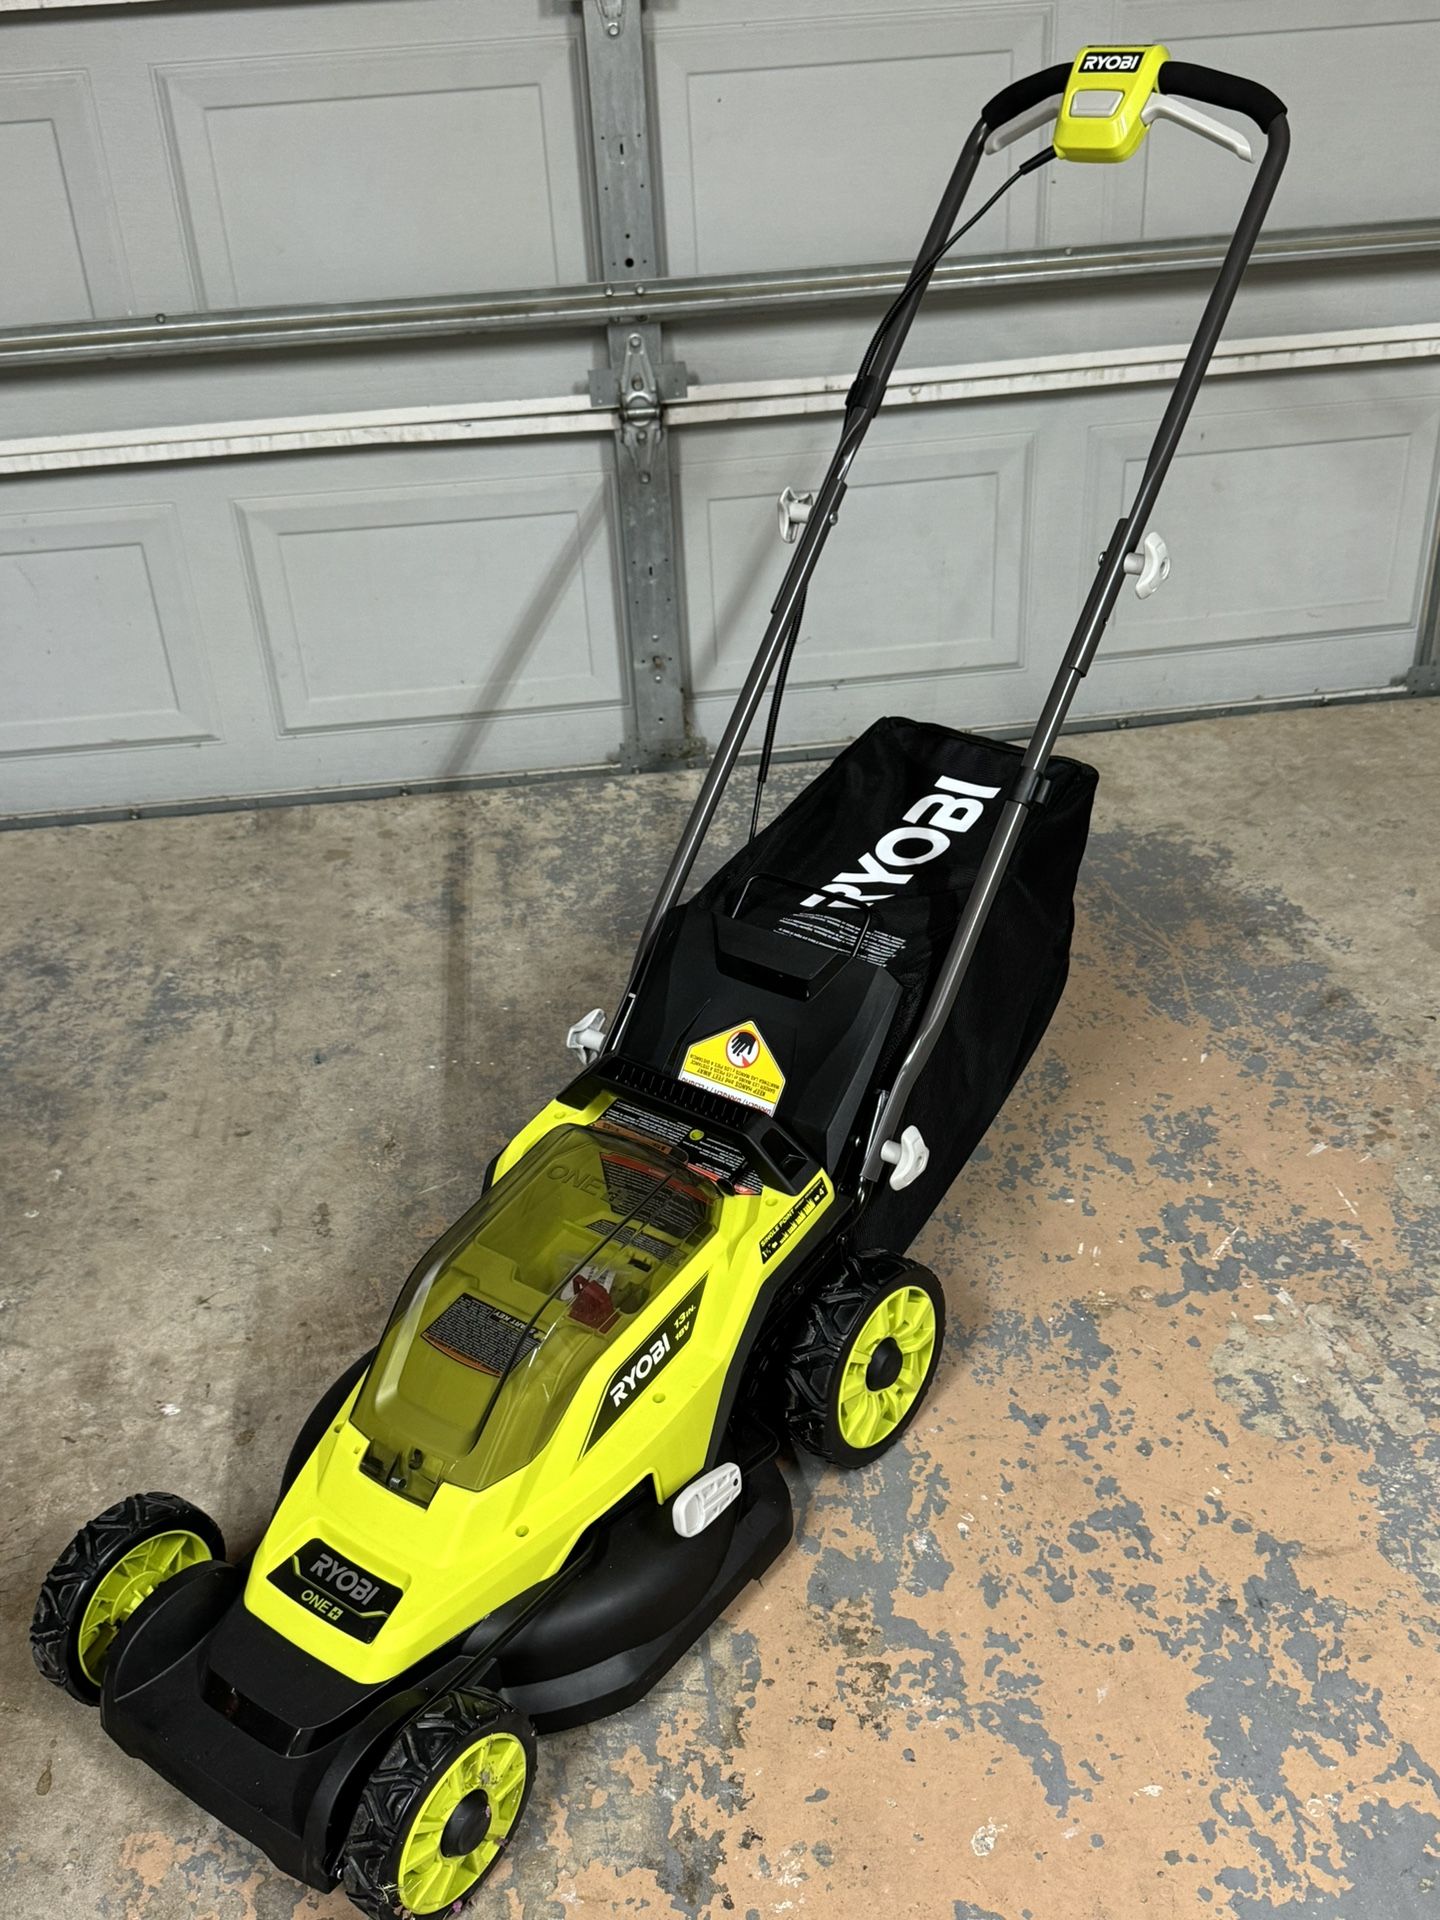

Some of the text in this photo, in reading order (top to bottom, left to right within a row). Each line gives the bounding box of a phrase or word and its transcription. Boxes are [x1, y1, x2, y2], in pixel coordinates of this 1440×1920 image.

[1083, 54, 1140, 70] RYOBI
[800, 775, 1001, 909] RYOBI
[696, 1067, 711, 1076] AWAY
[711, 1072, 724, 1081] FEET
[734, 1081, 752, 1091] HANDS
[752, 1087, 765, 1096] KEEP
[760, 1208, 795, 1247] SINGLE POINT
[610, 1332, 672, 1407] RYOBI
[310, 1552, 380, 1606] RYOBI
